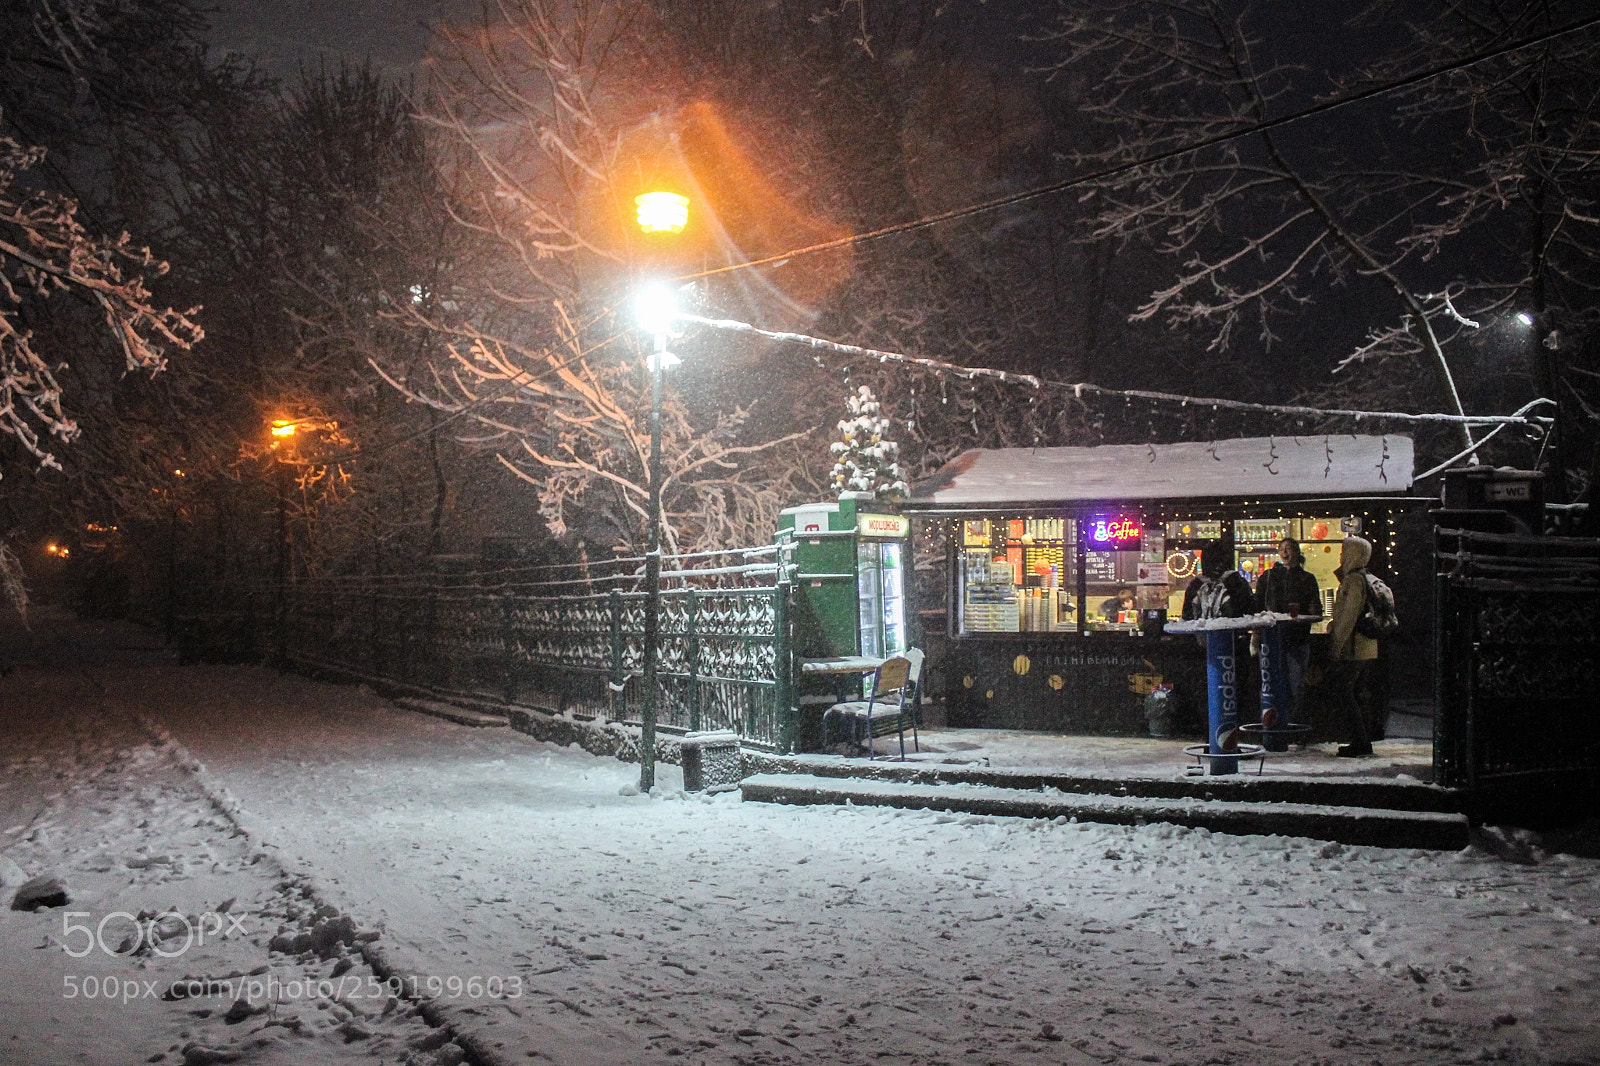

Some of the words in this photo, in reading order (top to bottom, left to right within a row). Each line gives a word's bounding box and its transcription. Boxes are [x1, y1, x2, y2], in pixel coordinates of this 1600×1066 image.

[1506, 487, 1525, 496] WC
[1107, 521, 1139, 540] Coffee
[1217, 656, 1237, 716] pepsi
[1261, 643, 1273, 697] pepsi
